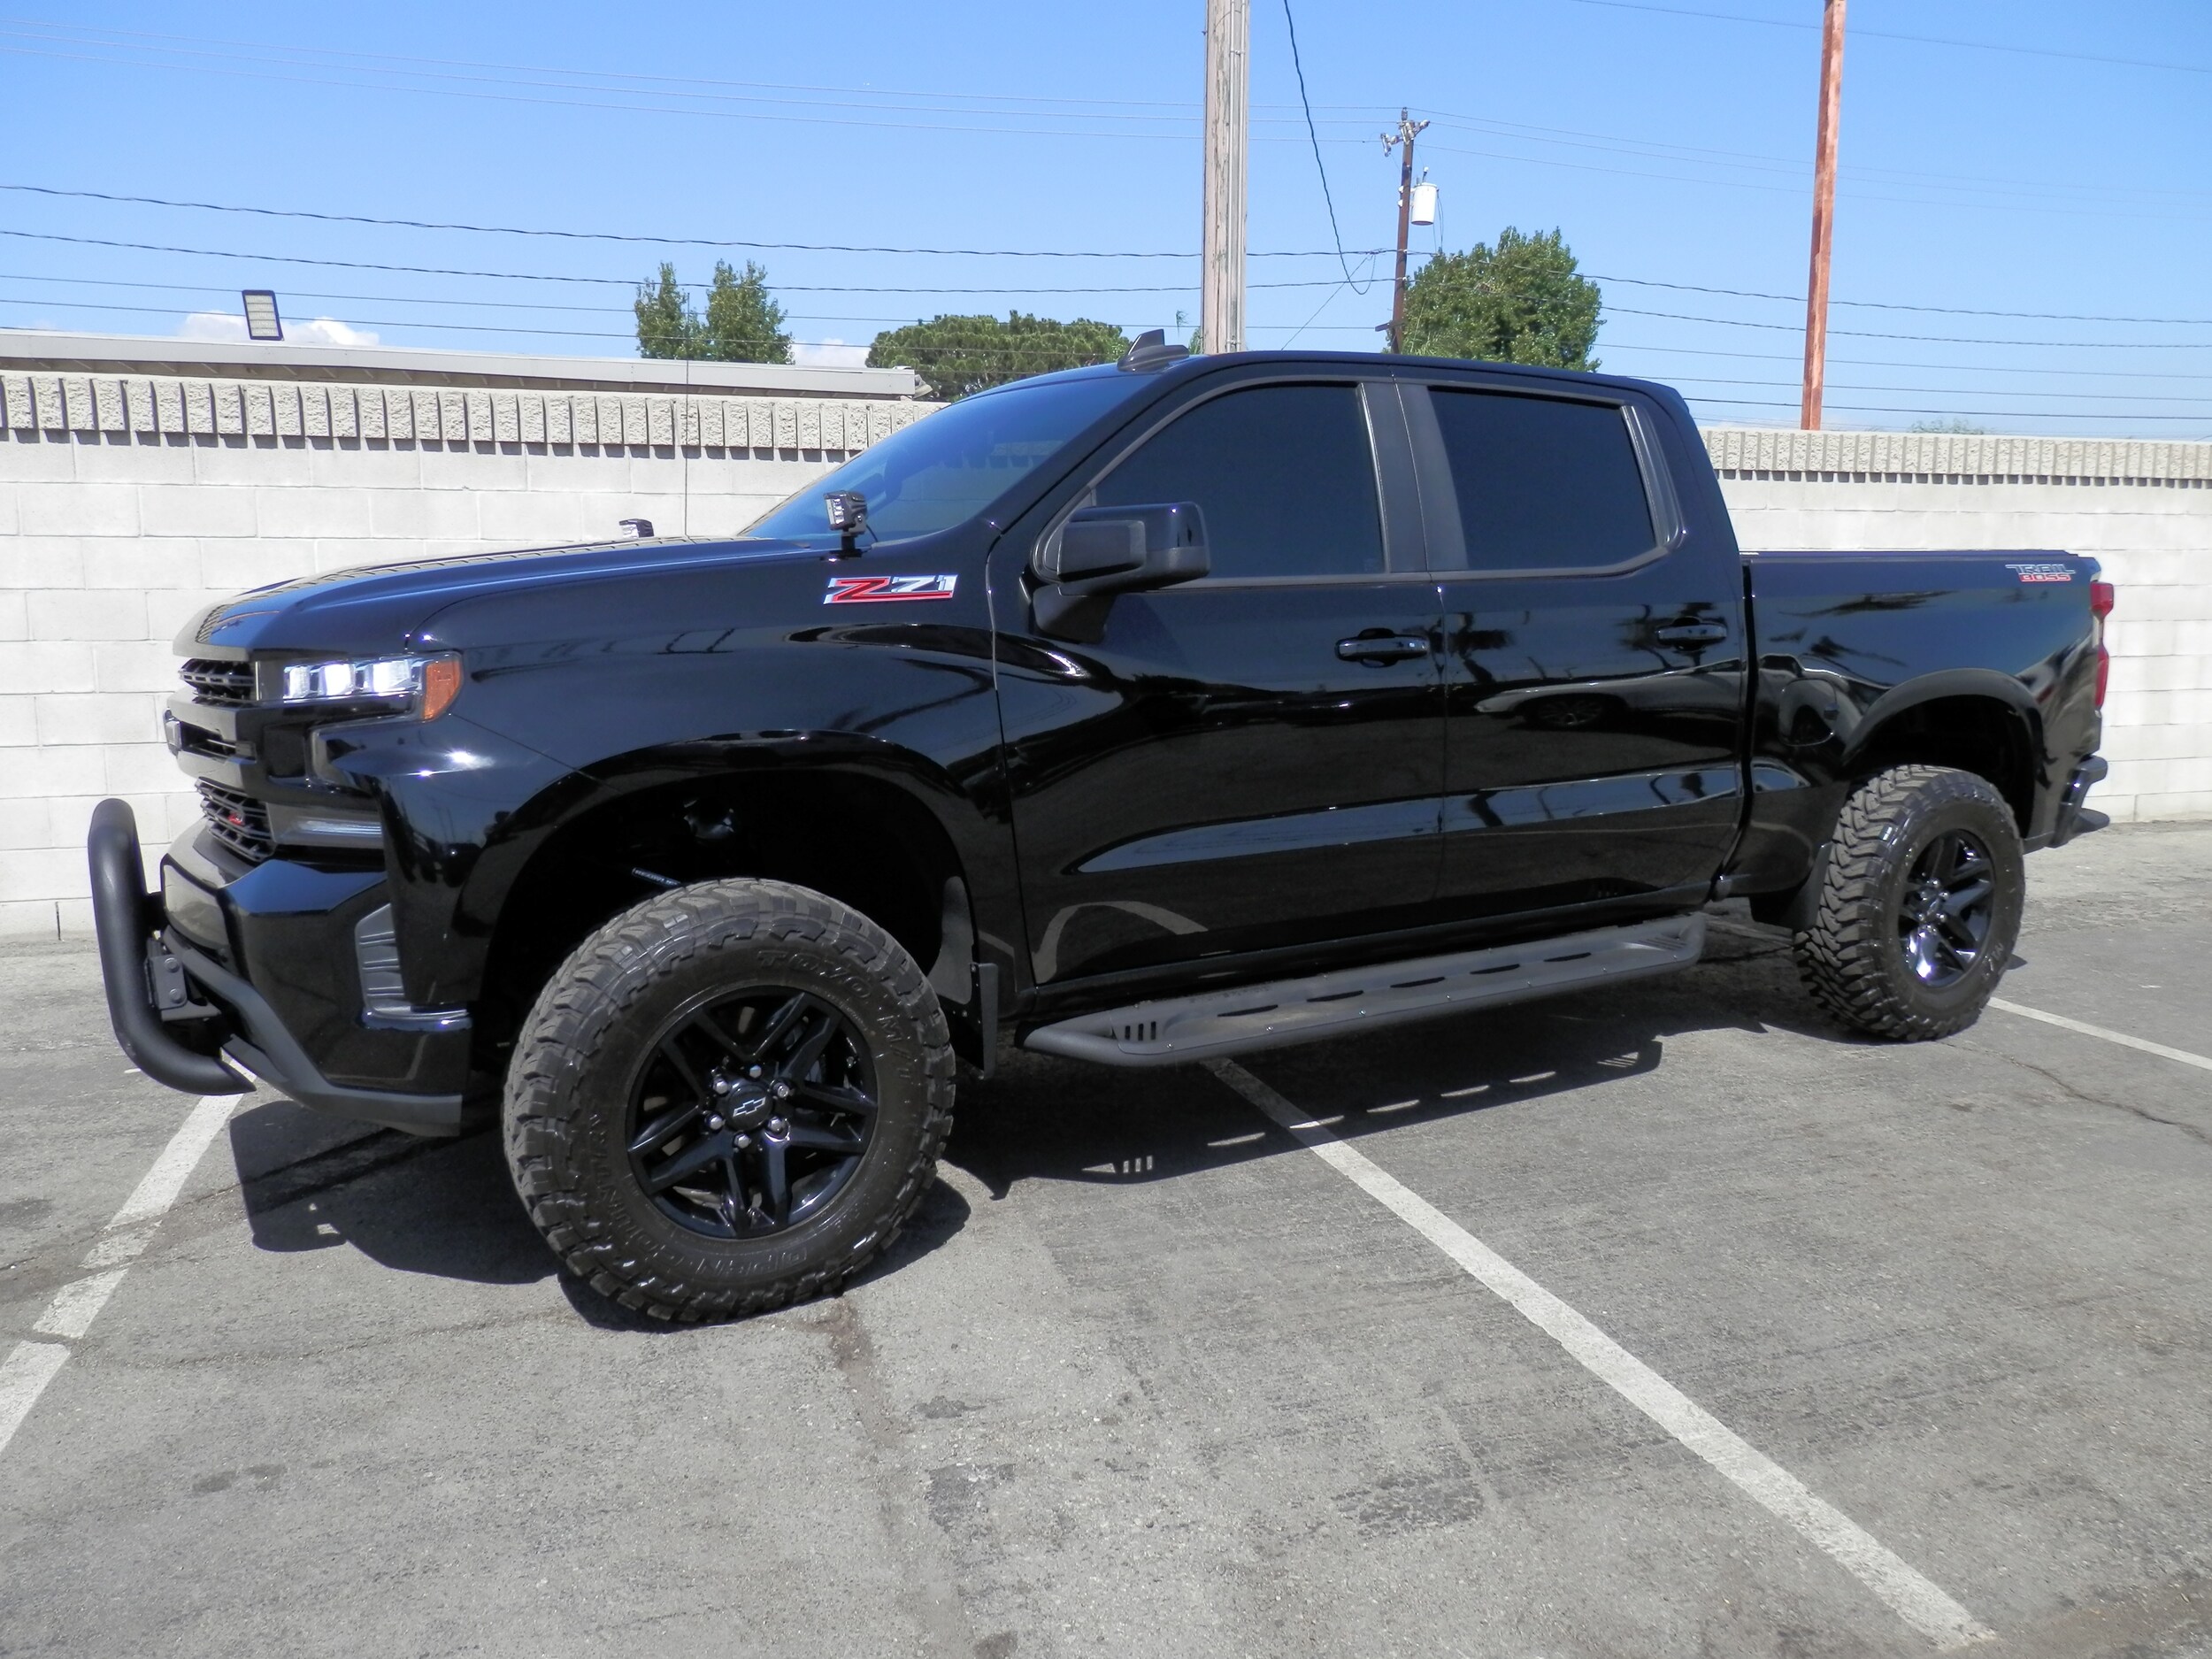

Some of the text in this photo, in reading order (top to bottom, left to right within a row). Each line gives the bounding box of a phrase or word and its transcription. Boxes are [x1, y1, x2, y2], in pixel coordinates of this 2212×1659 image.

[2005, 564, 2076, 574] TRAIL
[2019, 573, 2071, 582] BOSS
[823, 574, 958, 604] Z71
[757, 949, 872, 999] TOYO
